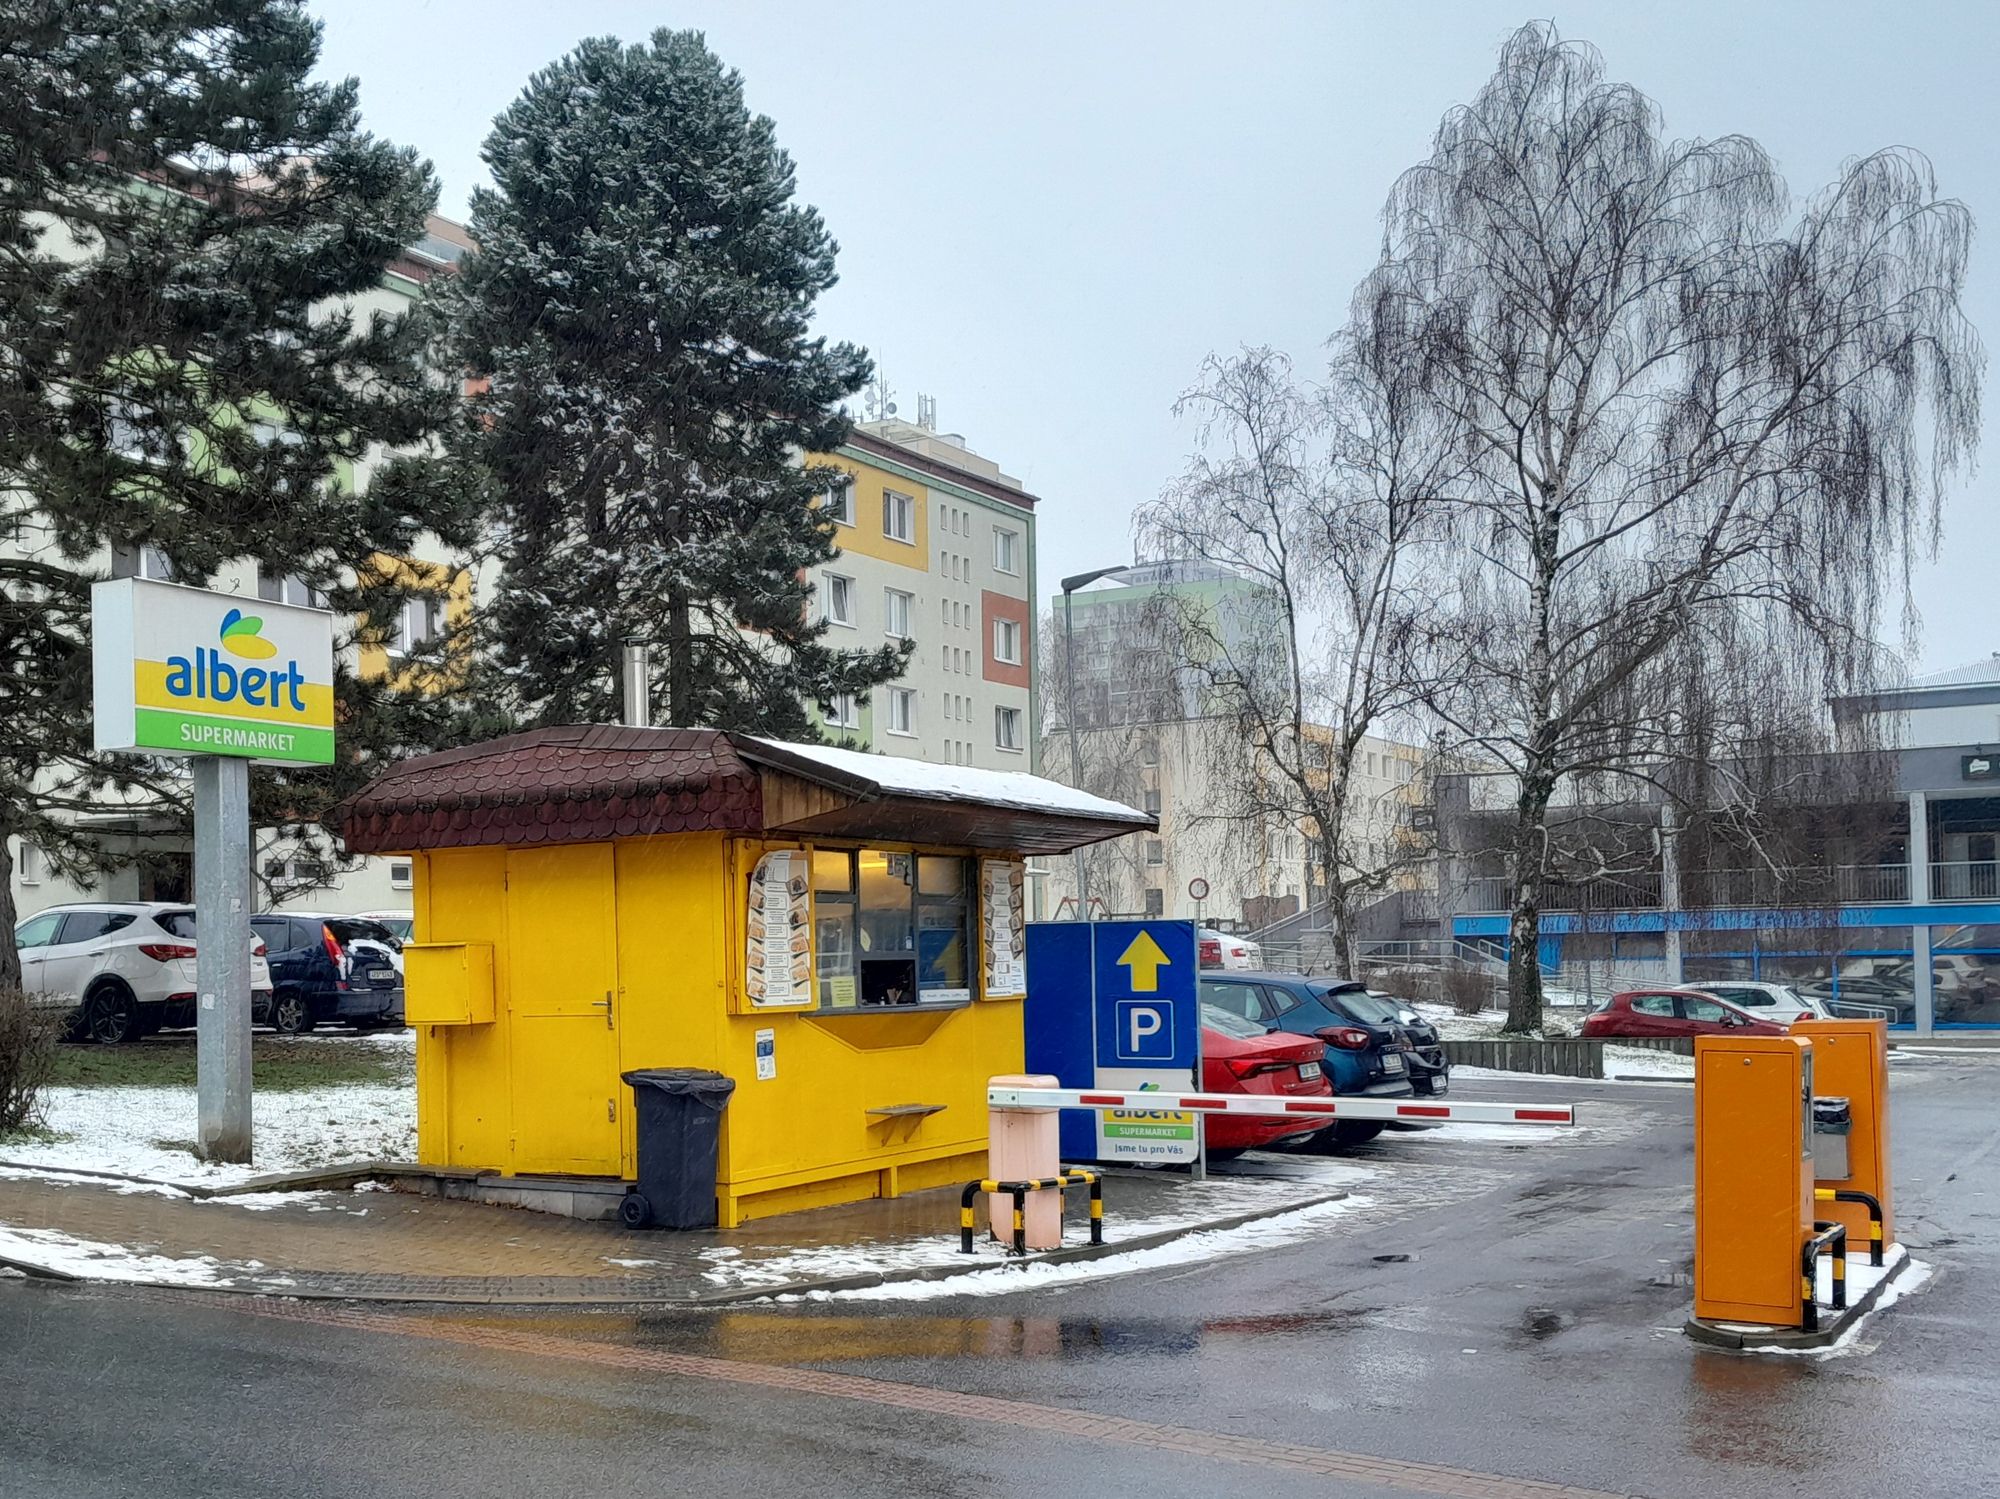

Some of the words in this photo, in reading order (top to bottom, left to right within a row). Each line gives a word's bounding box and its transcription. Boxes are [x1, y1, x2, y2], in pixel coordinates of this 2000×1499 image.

[165, 645, 306, 712] albert
[180, 722, 295, 752] SUPERMARKET
[1130, 1007, 1162, 1053] P
[1119, 1127, 1177, 1137] SUPERMARKET
[1114, 1143, 1137, 1153] Jsme
[1138, 1144, 1148, 1153] tu
[1150, 1146, 1165, 1155] pro
[1167, 1144, 1184, 1154] Vás
